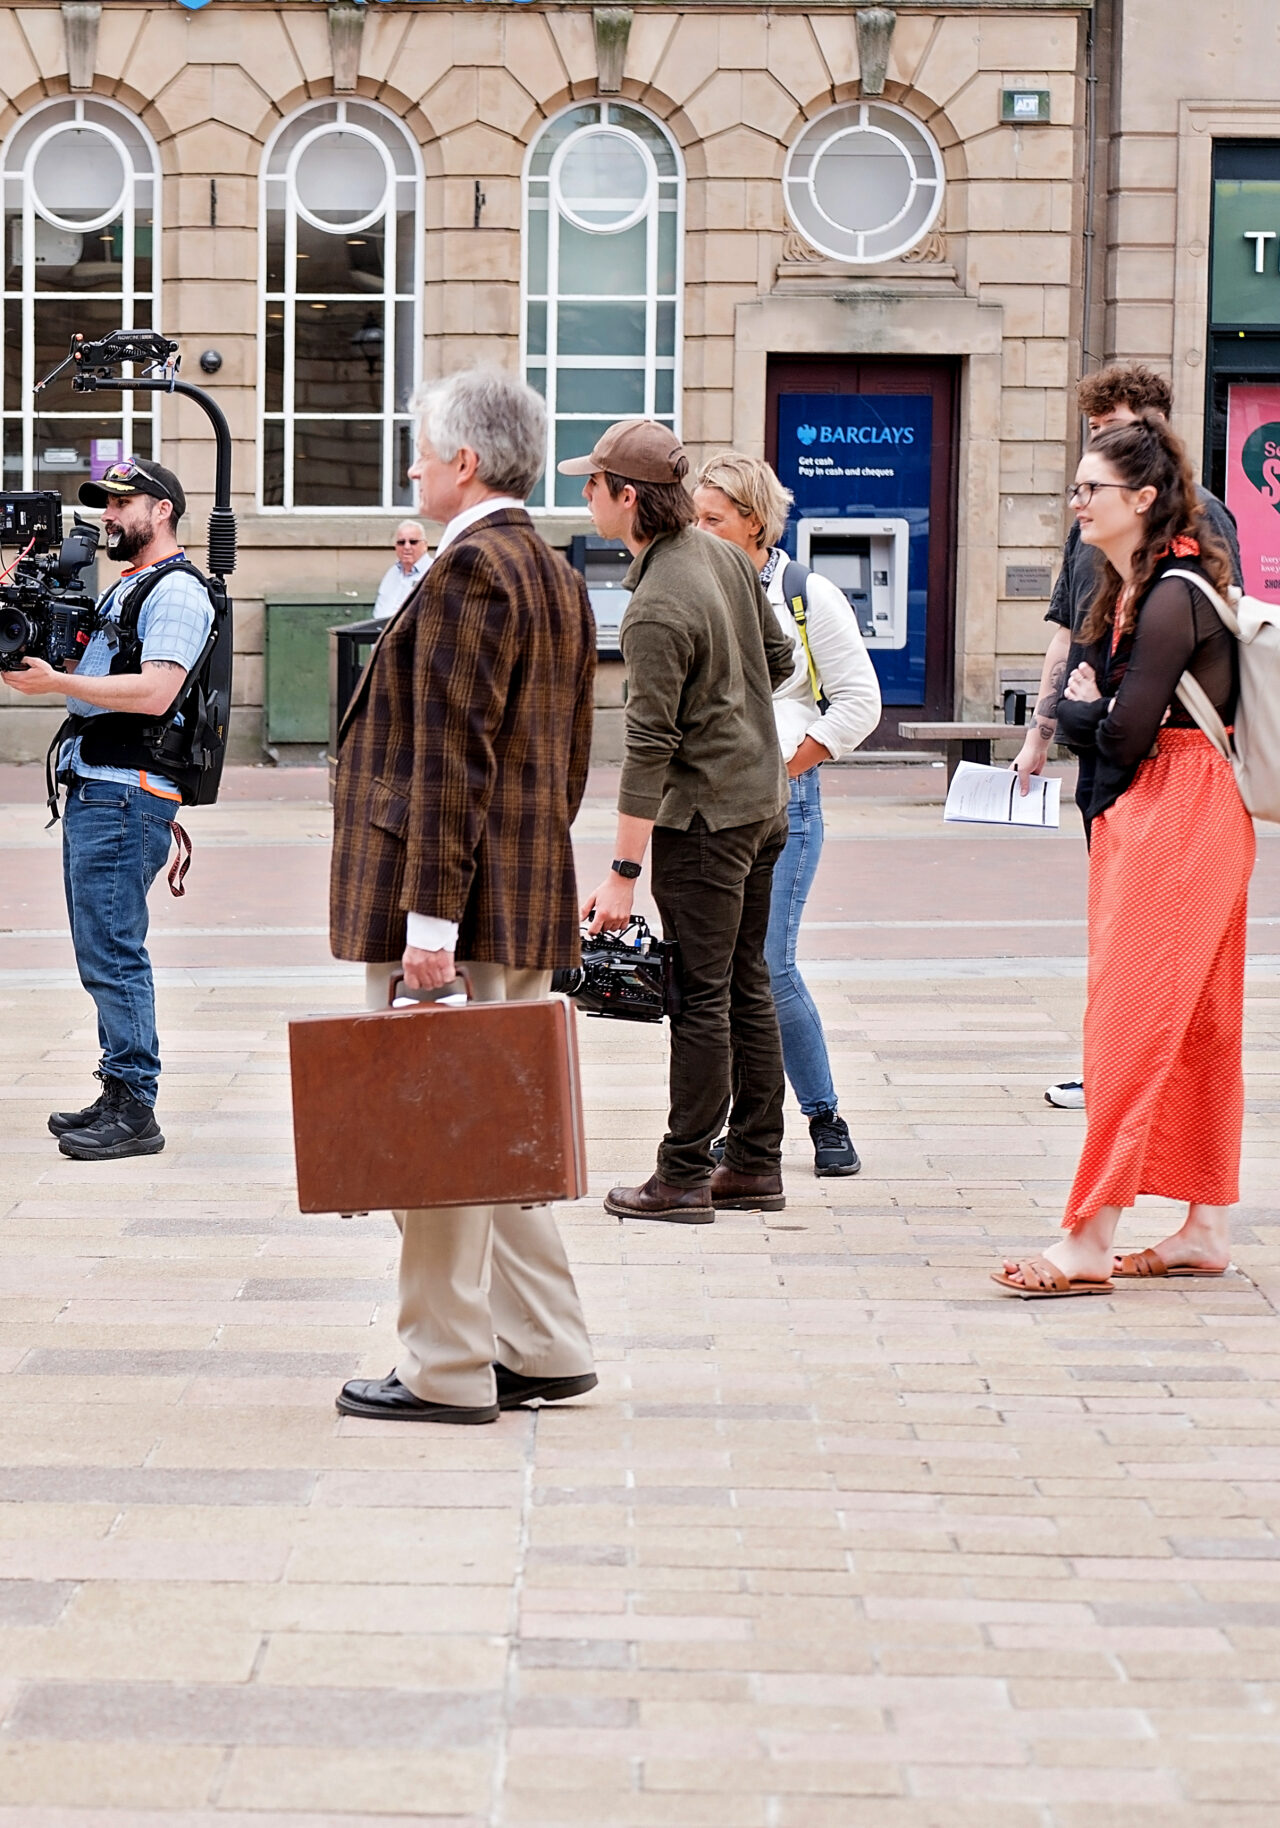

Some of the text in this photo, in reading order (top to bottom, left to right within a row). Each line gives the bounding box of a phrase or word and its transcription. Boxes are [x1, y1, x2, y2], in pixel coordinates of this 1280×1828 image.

[820, 426, 914, 444] BARCLAYS
[798, 456, 834, 466] Get cash
[798, 466, 895, 478] Pay in cash and cheques
